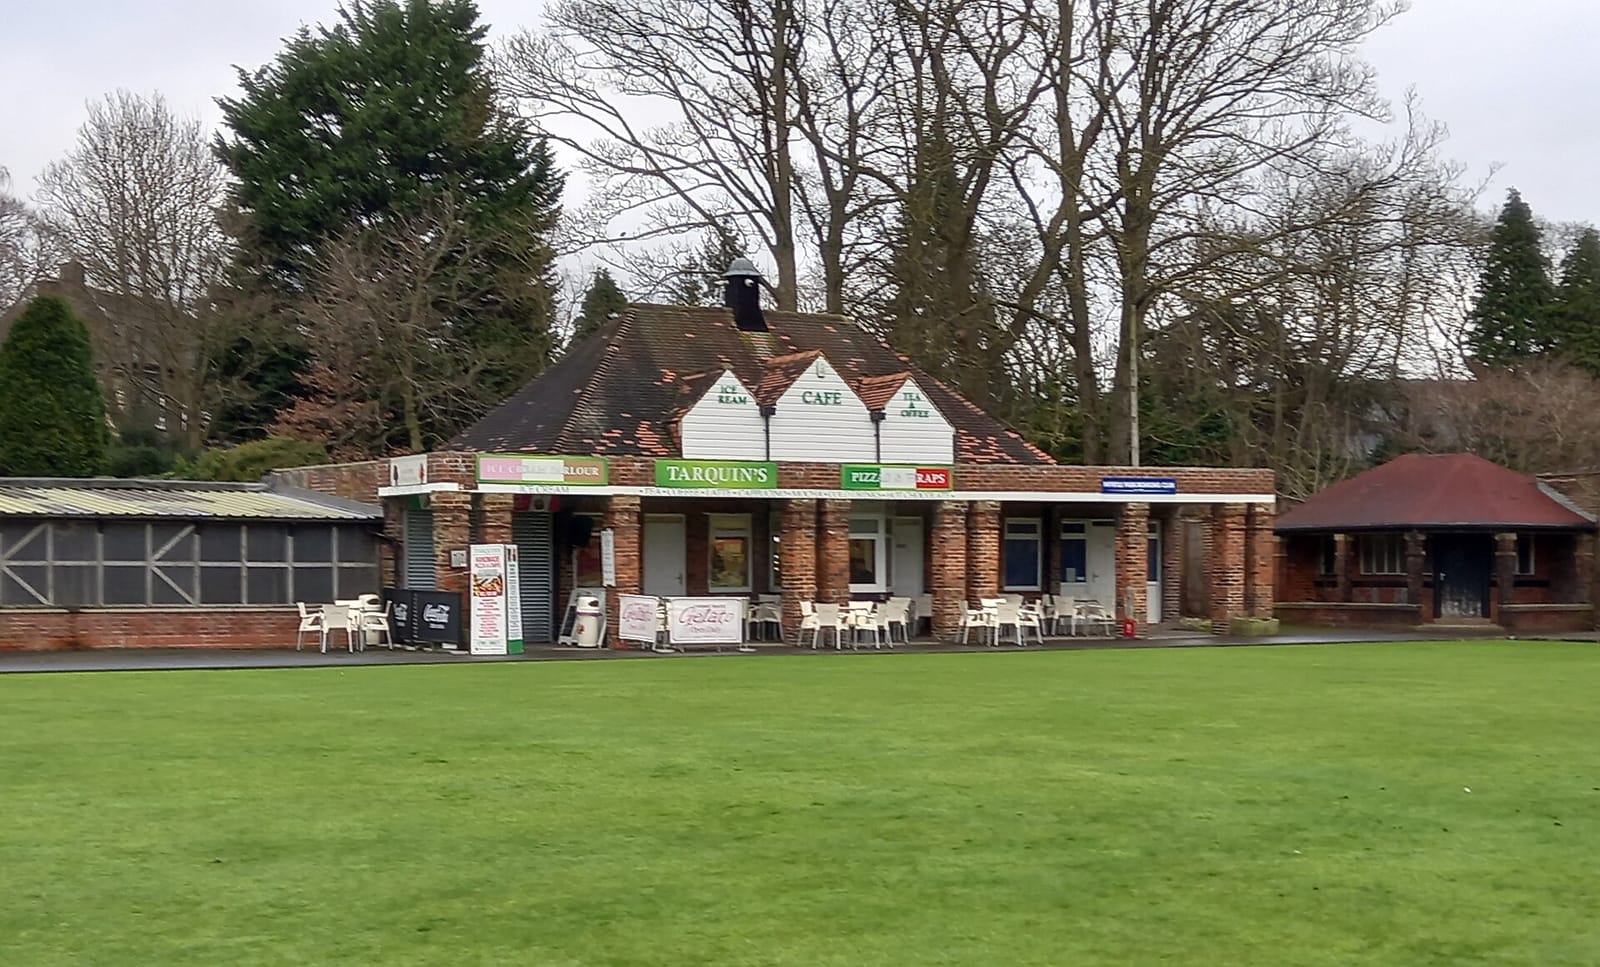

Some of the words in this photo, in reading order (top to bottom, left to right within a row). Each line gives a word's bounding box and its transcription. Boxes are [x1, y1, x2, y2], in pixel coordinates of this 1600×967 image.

[903, 393, 921, 401] TEA
[666, 466, 768, 484] TARQUIN'S
[851, 472, 884, 482] PIZZ
[679, 606, 735, 626] Gelato
